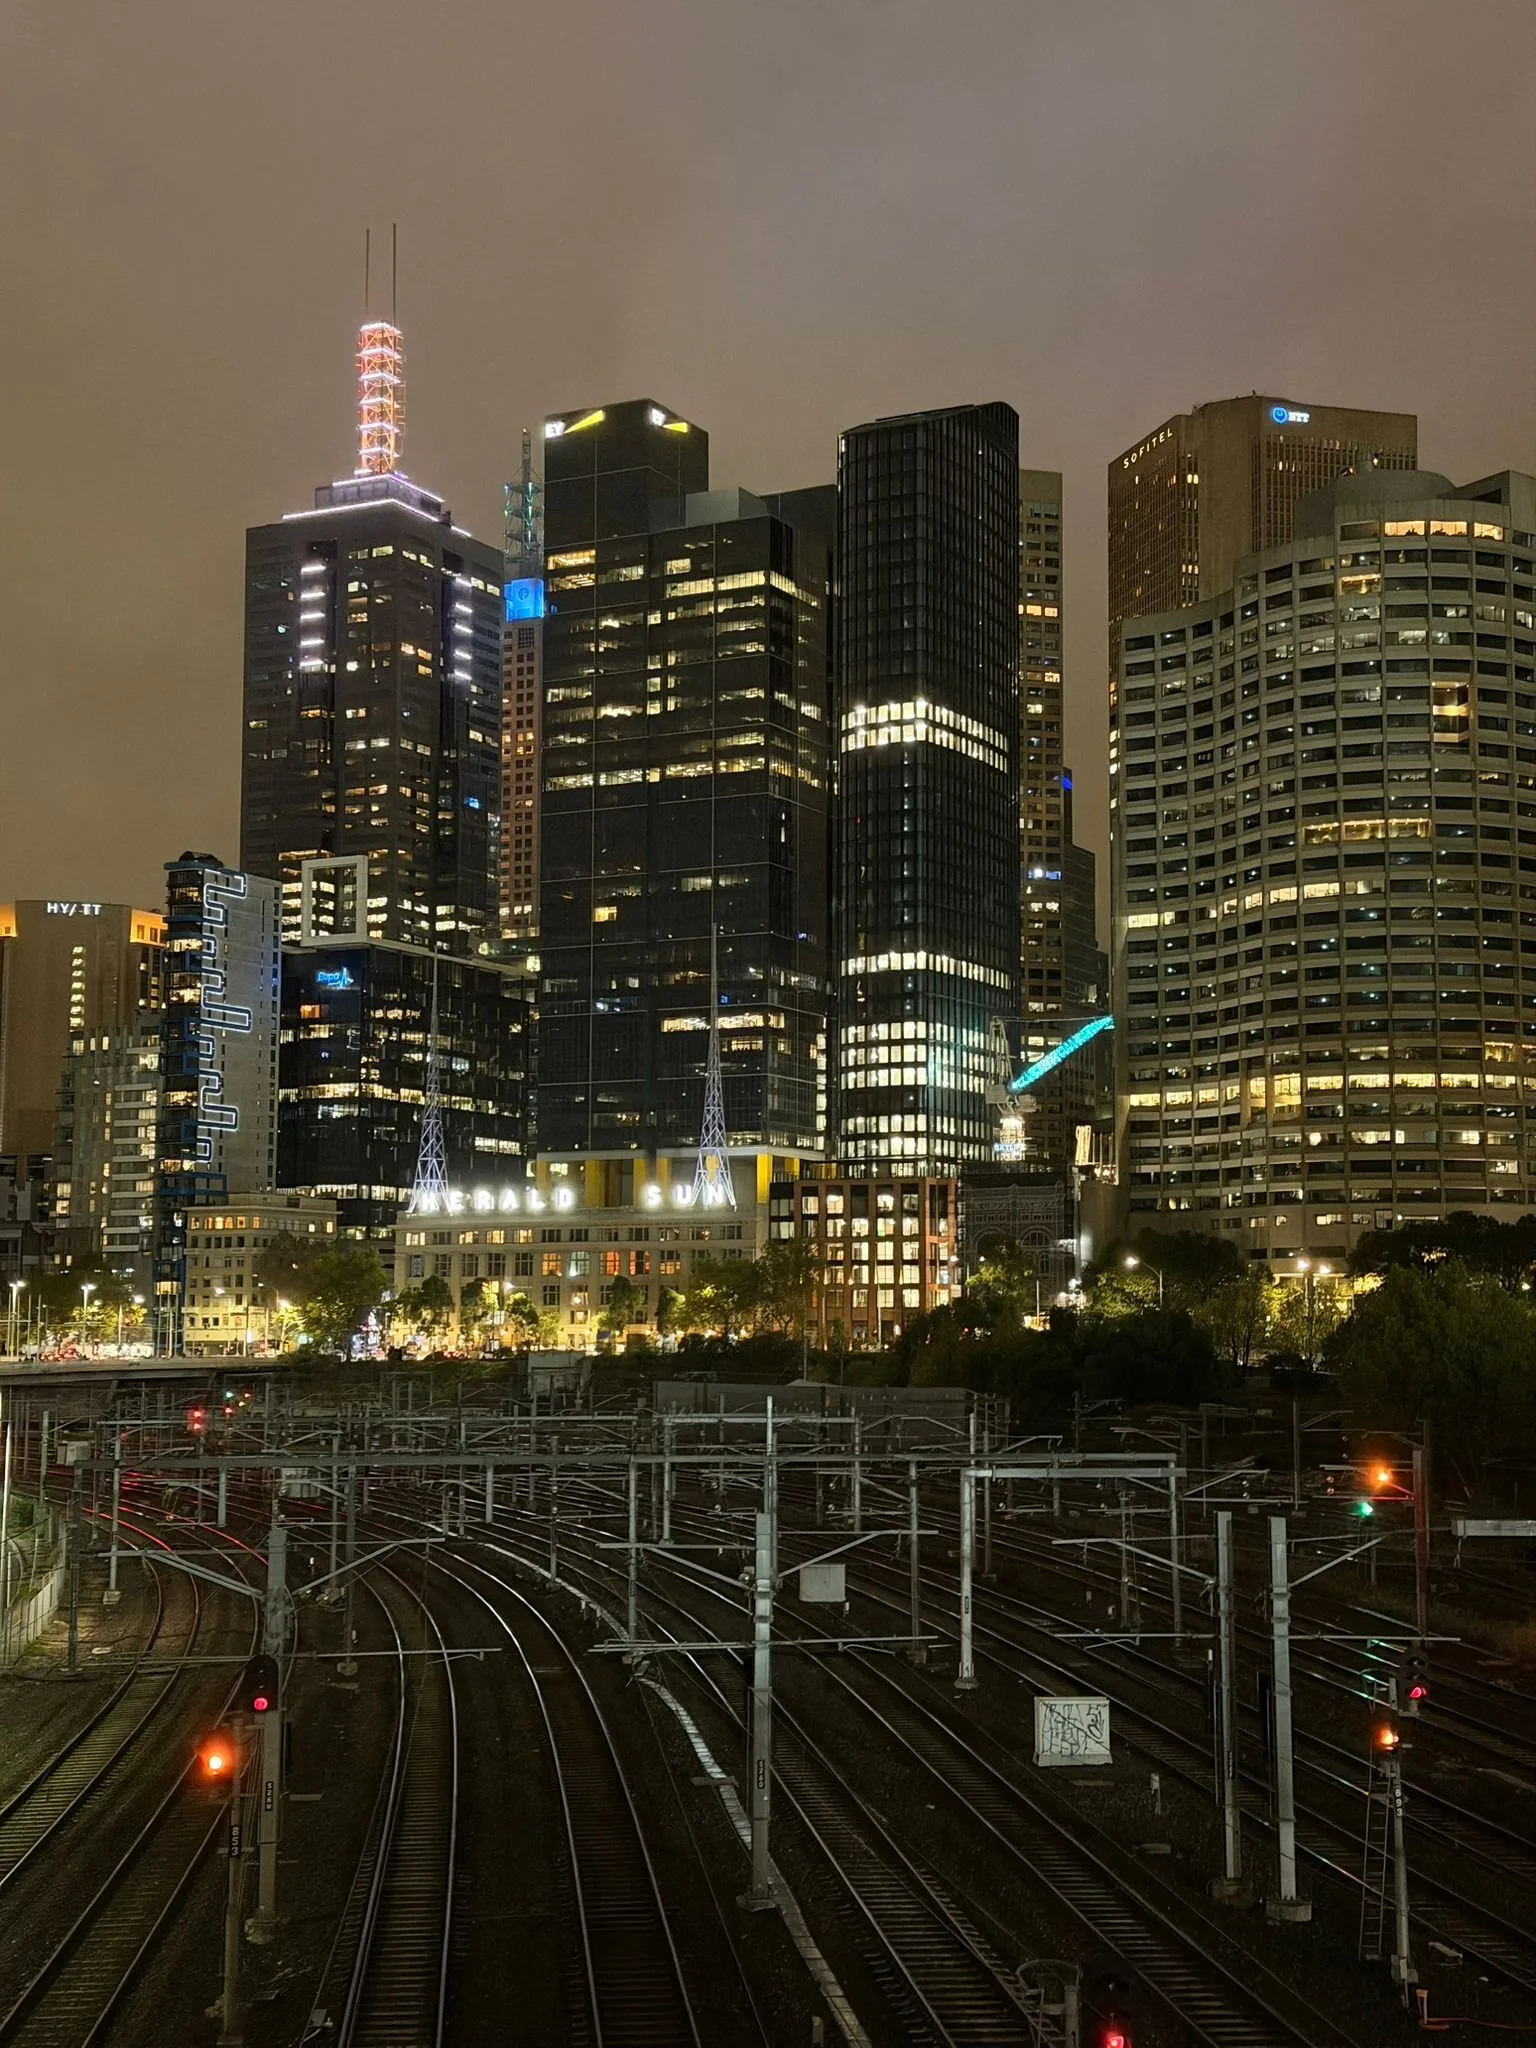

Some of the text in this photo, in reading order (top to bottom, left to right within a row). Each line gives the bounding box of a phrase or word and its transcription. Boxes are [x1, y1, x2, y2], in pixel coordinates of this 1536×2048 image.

[545, 421, 565, 438] EY
[1123, 427, 1173, 469] SOFITEL
[422, 1184, 724, 1210] HERALD SUN
[231, 1826, 240, 1856] 853
